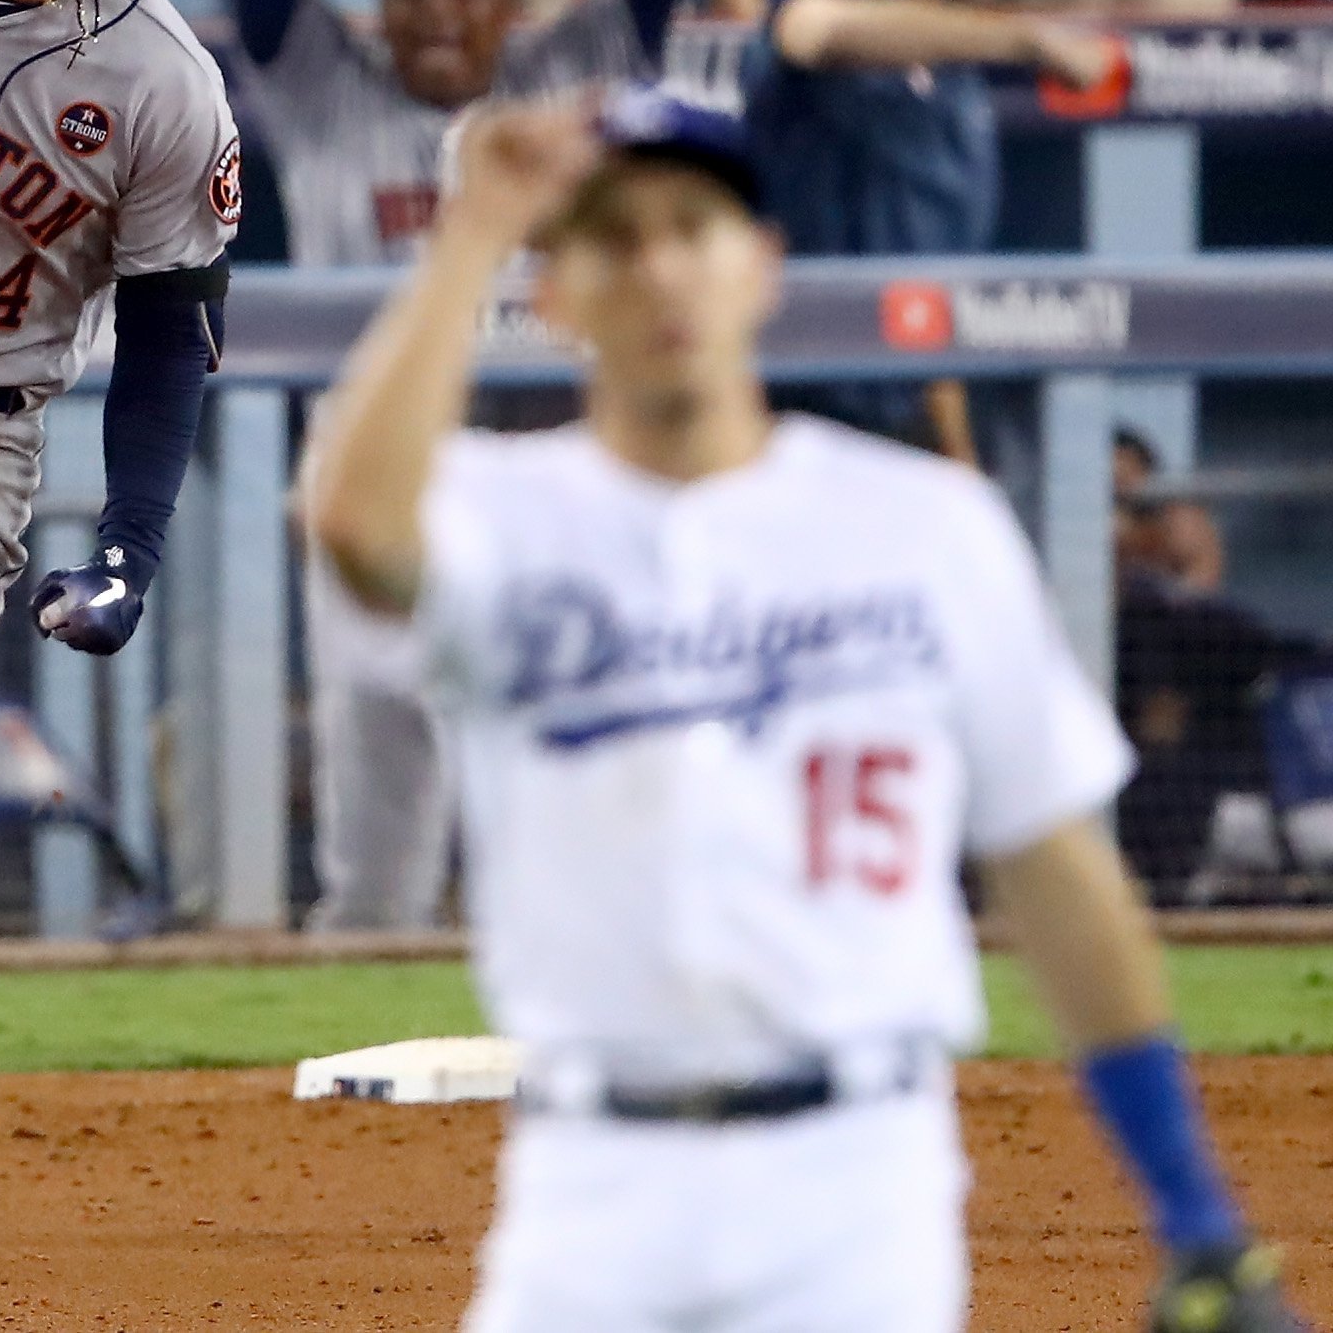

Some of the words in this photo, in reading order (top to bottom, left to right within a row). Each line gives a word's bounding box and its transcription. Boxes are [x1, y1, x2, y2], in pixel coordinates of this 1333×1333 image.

[60, 117, 107, 142] STRONG
[497, 571, 949, 751] Dodgers
[800, 745, 919, 903] 15
